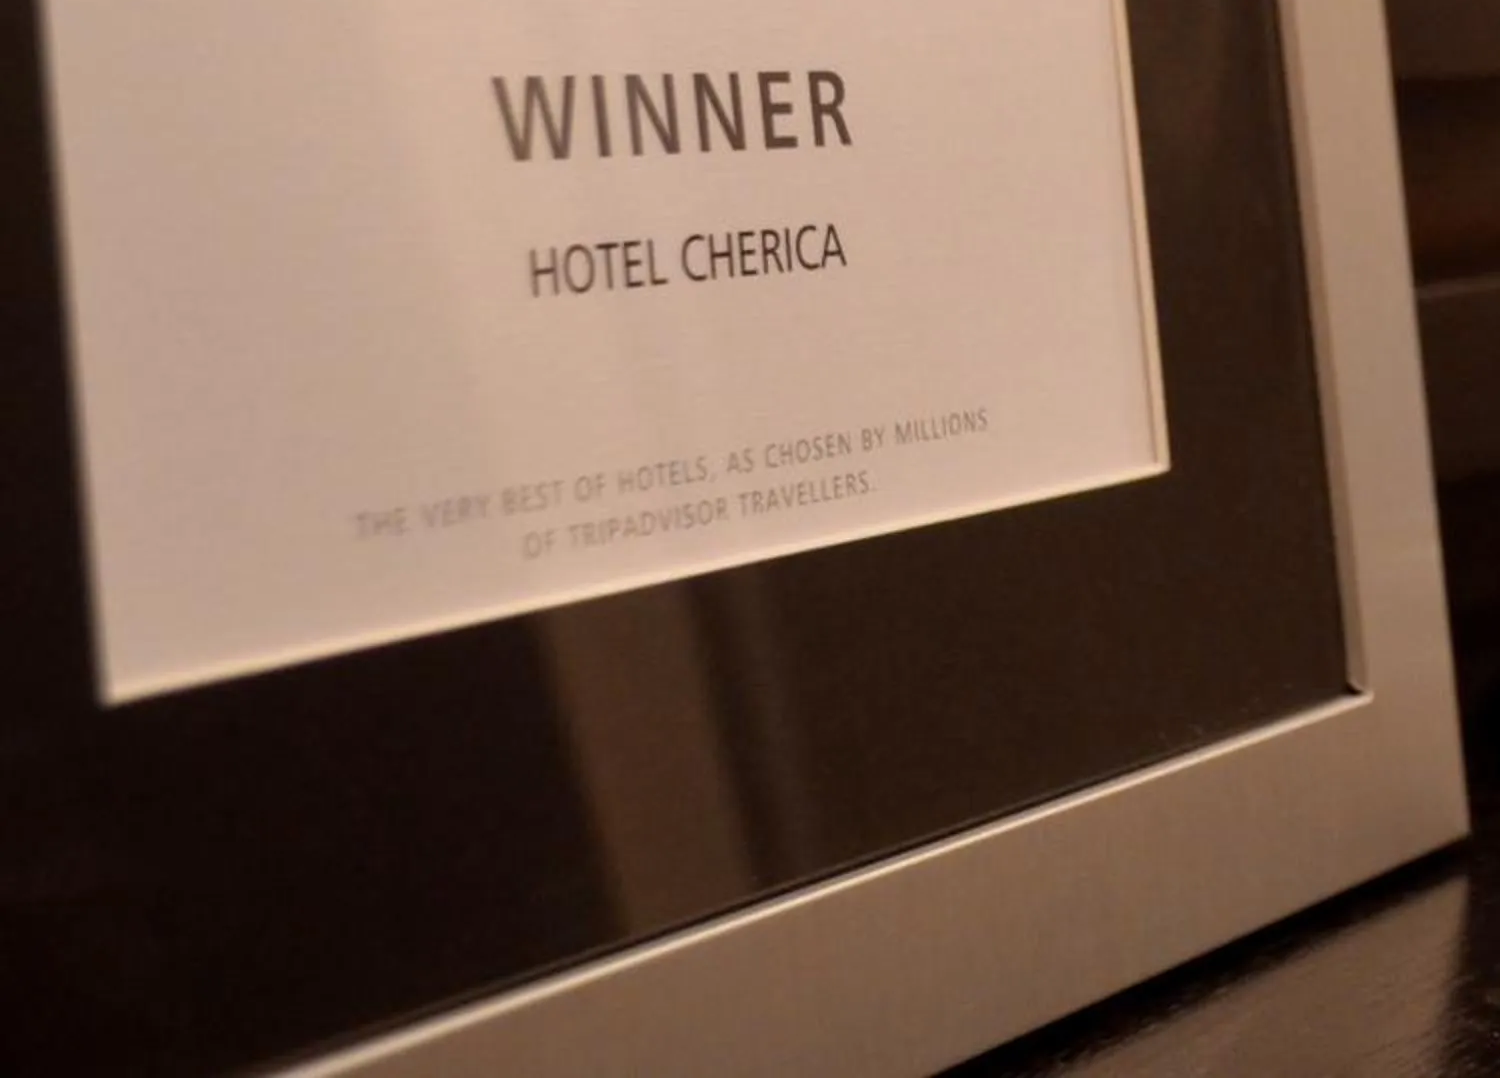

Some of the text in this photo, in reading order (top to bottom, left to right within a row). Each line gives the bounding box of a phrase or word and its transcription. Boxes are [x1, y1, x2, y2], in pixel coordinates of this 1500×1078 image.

[491, 70, 853, 161] WINNER
[528, 223, 848, 298] HOTEL CHERICA
[355, 407, 989, 537] THE VERY BEST OF HOTELS, AS CHOSEN BY MILLIONS
[523, 527, 558, 561] OF
[568, 496, 729, 549] TRIPADVISOR
